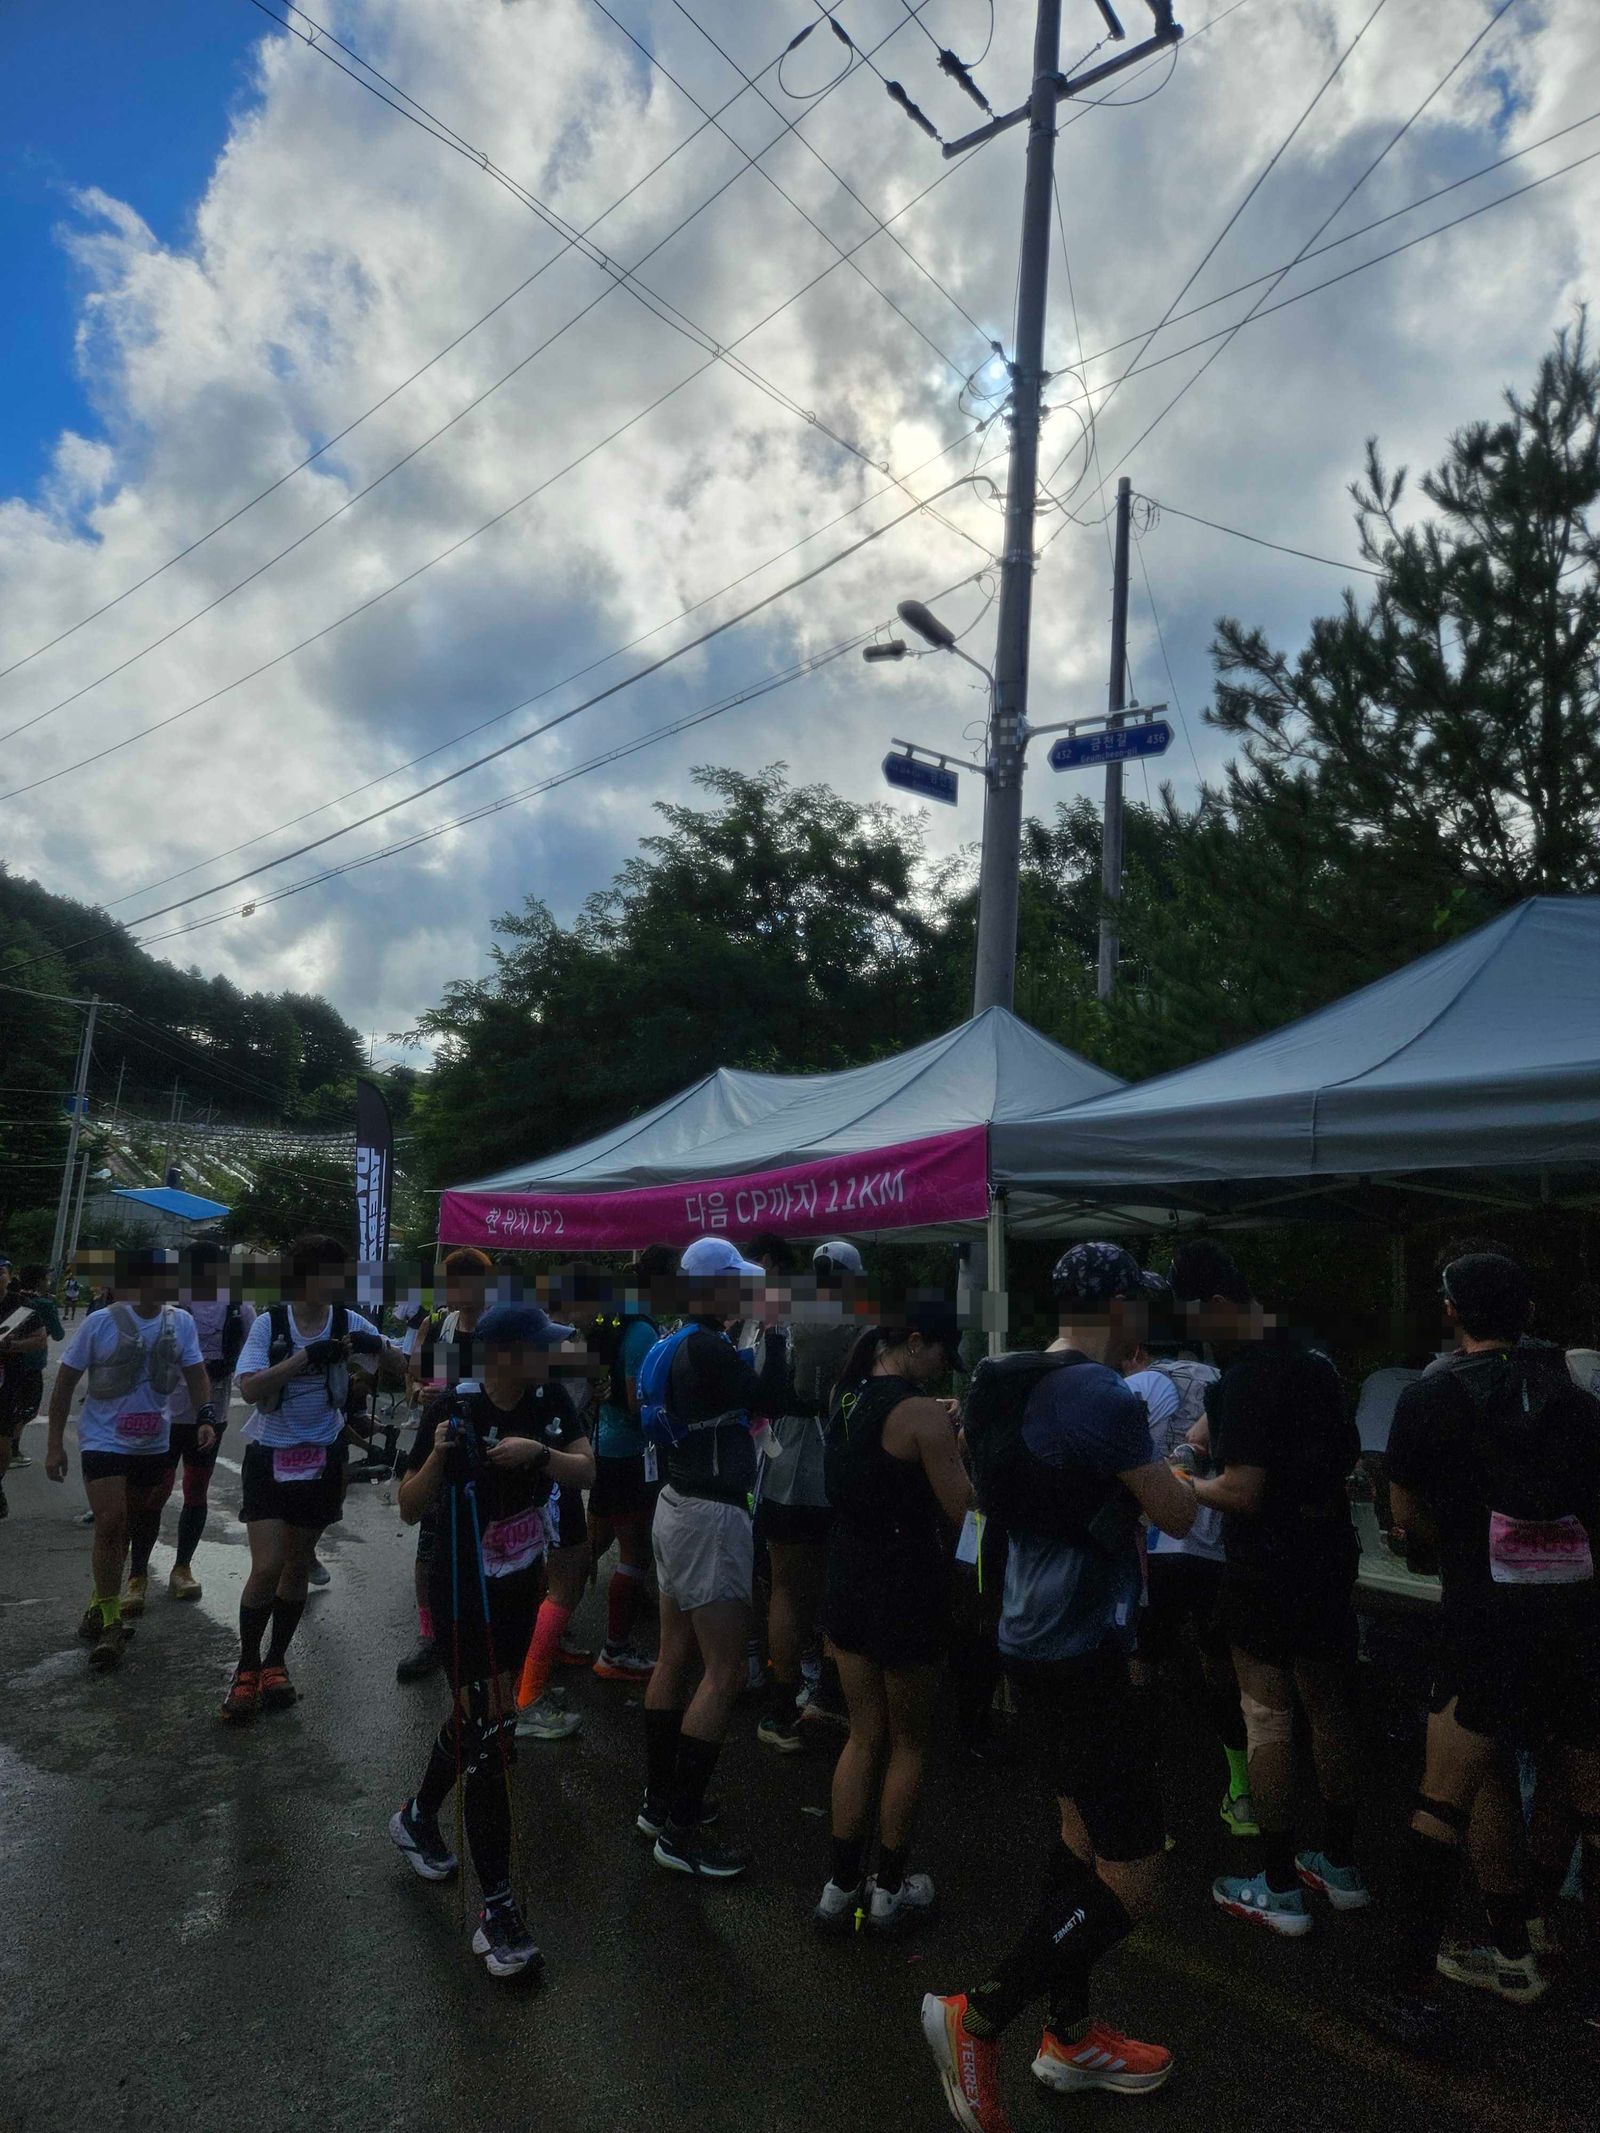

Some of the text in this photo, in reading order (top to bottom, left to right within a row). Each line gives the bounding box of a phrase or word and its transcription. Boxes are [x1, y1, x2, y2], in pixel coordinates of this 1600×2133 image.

[1090, 731, 1128, 752] 금천길
[685, 1168, 905, 1230] 다음 CP까지 11KM
[485, 1208, 565, 1236] 현 위치 CP 2
[961, 2040, 981, 2108] TERREX
